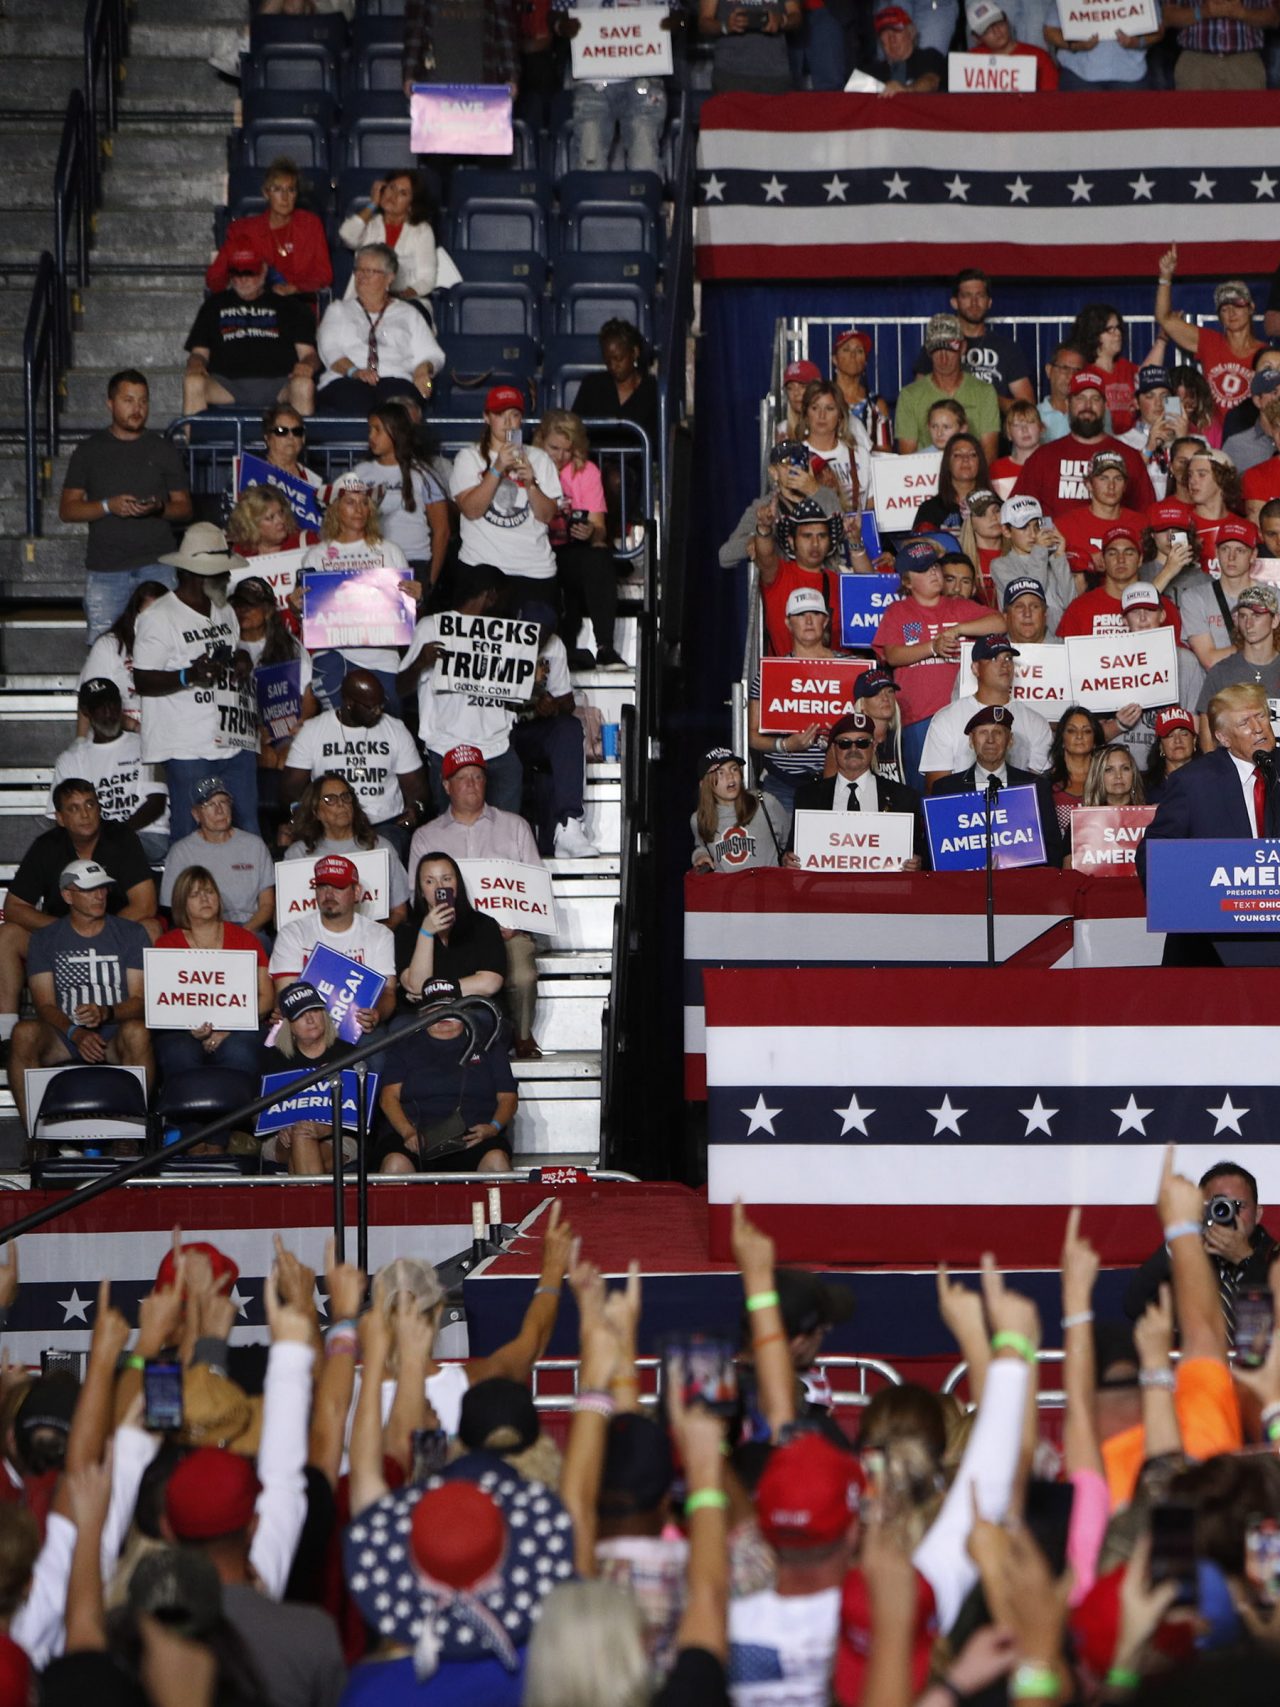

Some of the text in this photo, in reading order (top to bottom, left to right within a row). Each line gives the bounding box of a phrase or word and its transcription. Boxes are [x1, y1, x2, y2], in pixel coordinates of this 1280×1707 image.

[1069, 5, 1144, 21] AMERICA!
[599, 25, 642, 39] SAVE
[582, 44, 661, 58] AMERICA!
[964, 68, 1020, 89] VANCE
[967, 348, 999, 367] OD
[1060, 459, 1089, 477] ULT
[904, 474, 940, 488] SAV
[266, 474, 307, 506] SAVE
[1058, 482, 1091, 499] MA
[886, 495, 932, 509] AMER
[266, 572, 291, 587] VE
[1009, 581, 1039, 594] TRUMP
[870, 593, 905, 607] SAV
[1126, 591, 1151, 601] AMERICA
[1093, 614, 1124, 626] PENG
[183, 623, 232, 643] BLACKS
[439, 615, 538, 646] BLACKS
[472, 641, 501, 655] FOR
[441, 651, 534, 685] TRUMP
[1100, 651, 1148, 670] SAVE
[791, 679, 840, 694] SAVE
[1080, 670, 1169, 691] AMERICA!
[267, 681, 289, 699] SAVE
[1013, 686, 1064, 700] RICA!
[768, 698, 855, 715] AMERICA
[1160, 709, 1190, 725] MAGA
[323, 741, 389, 757] BLACKS
[705, 747, 733, 760] TRUMP
[346, 756, 367, 767] FOR
[98, 769, 139, 788] ACKS
[101, 794, 140, 811] UMP
[958, 809, 1008, 828] SAVE
[829, 832, 880, 848] SAVE
[940, 828, 1033, 854] AMERICA!
[1103, 827, 1146, 843] SAV
[806, 854, 903, 870] AMERICA!
[1082, 850, 1136, 865] AMER
[480, 877, 526, 894] SAVE
[1233, 901, 1256, 909] TEXT
[178, 970, 225, 985] SAVE
[284, 988, 314, 1006] TRUMP
[424, 983, 455, 996] TRUMP
[157, 992, 247, 1007] AMERICA!
[267, 1096, 357, 1115] AMERIA
